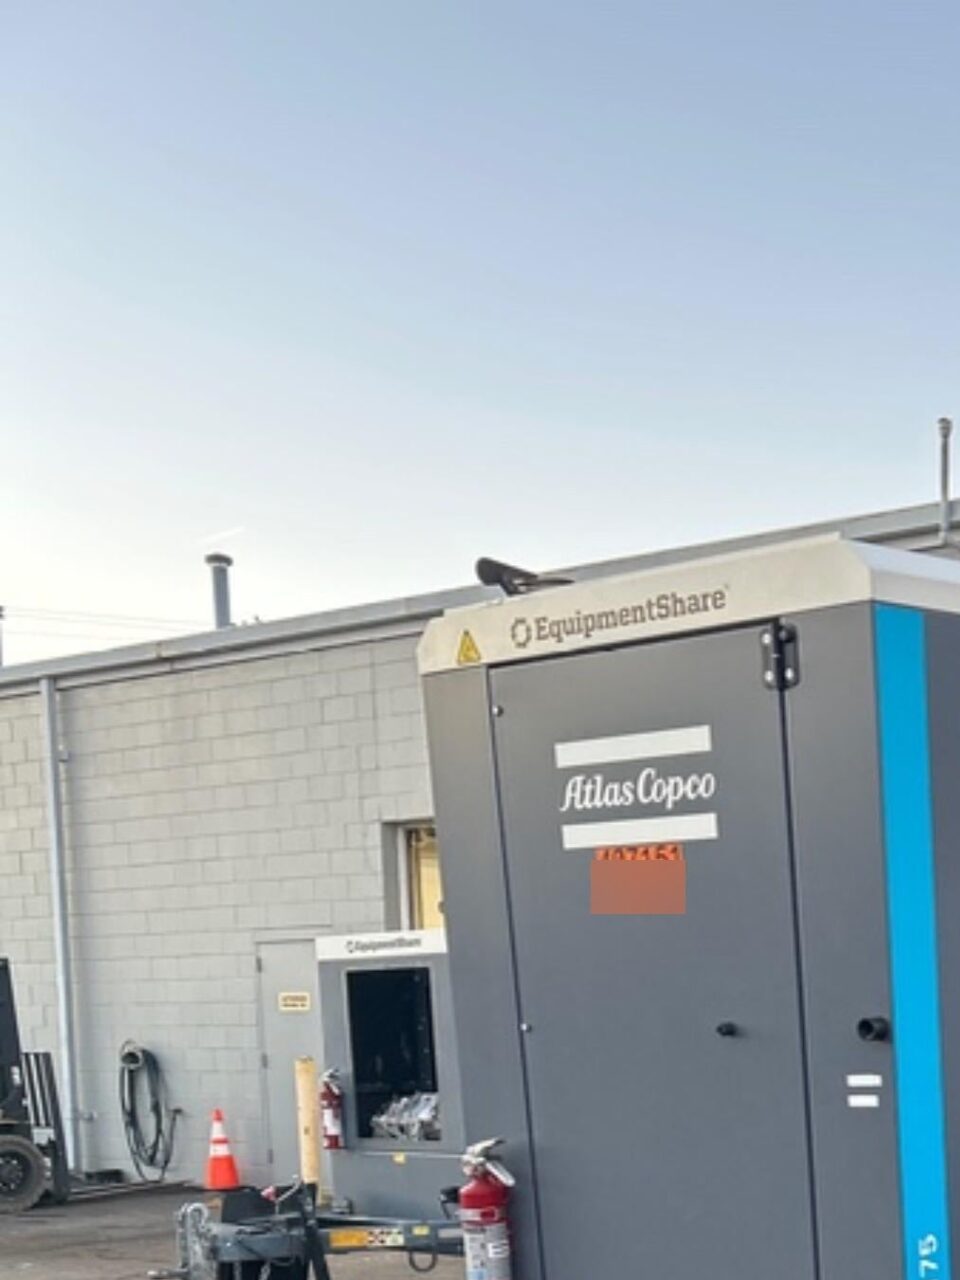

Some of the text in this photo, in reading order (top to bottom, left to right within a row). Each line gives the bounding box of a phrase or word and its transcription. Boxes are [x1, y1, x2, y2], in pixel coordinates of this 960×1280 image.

[534, 589, 726, 643] EquipmentShare
[559, 767, 716, 812] Atlas Copco
